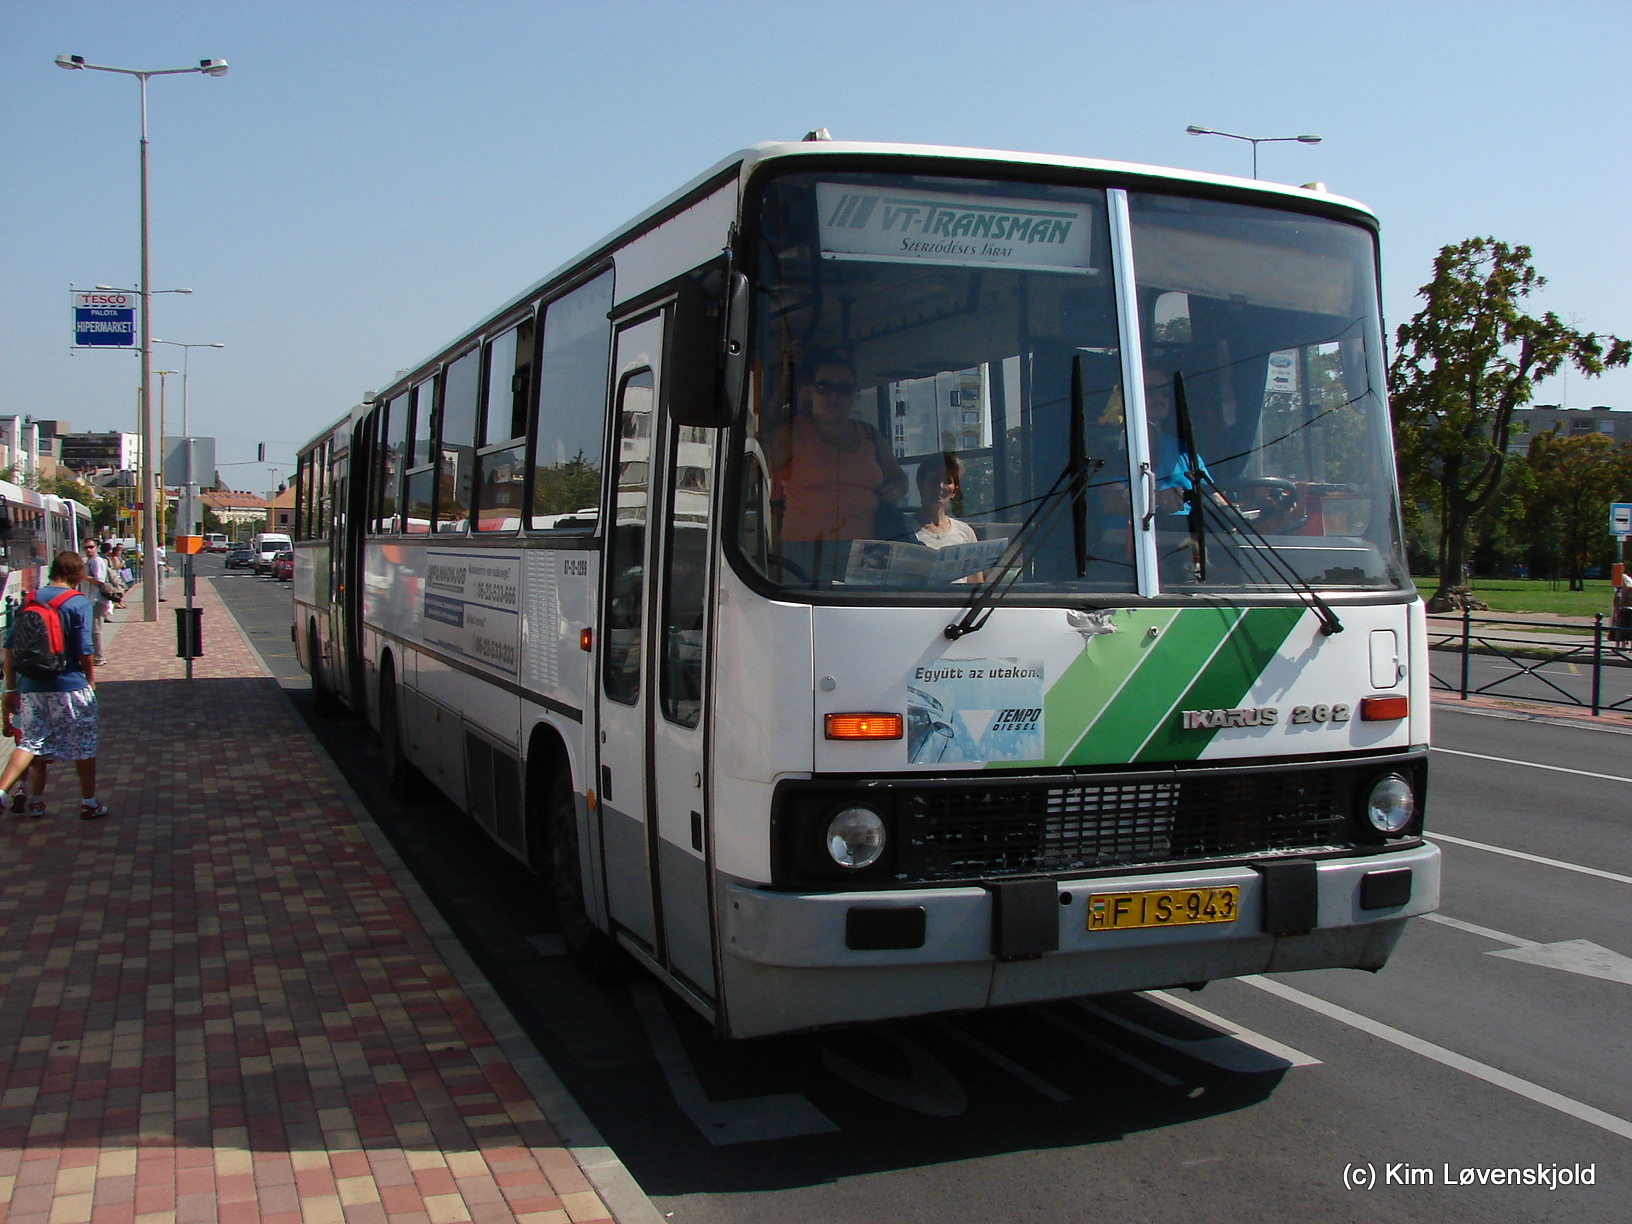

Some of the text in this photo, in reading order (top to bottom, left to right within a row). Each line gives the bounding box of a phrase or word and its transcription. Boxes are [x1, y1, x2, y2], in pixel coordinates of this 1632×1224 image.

[82, 295, 126, 304] TESCO
[77, 321, 132, 333] HIPERMARKET
[915, 666, 1040, 682] Együtt az utakon.
[996, 708, 1042, 723] TEMPO
[1182, 703, 1350, 729] IKARUS 282
[992, 723, 1036, 731] DIESEL
[1092, 912, 1105, 926] H
